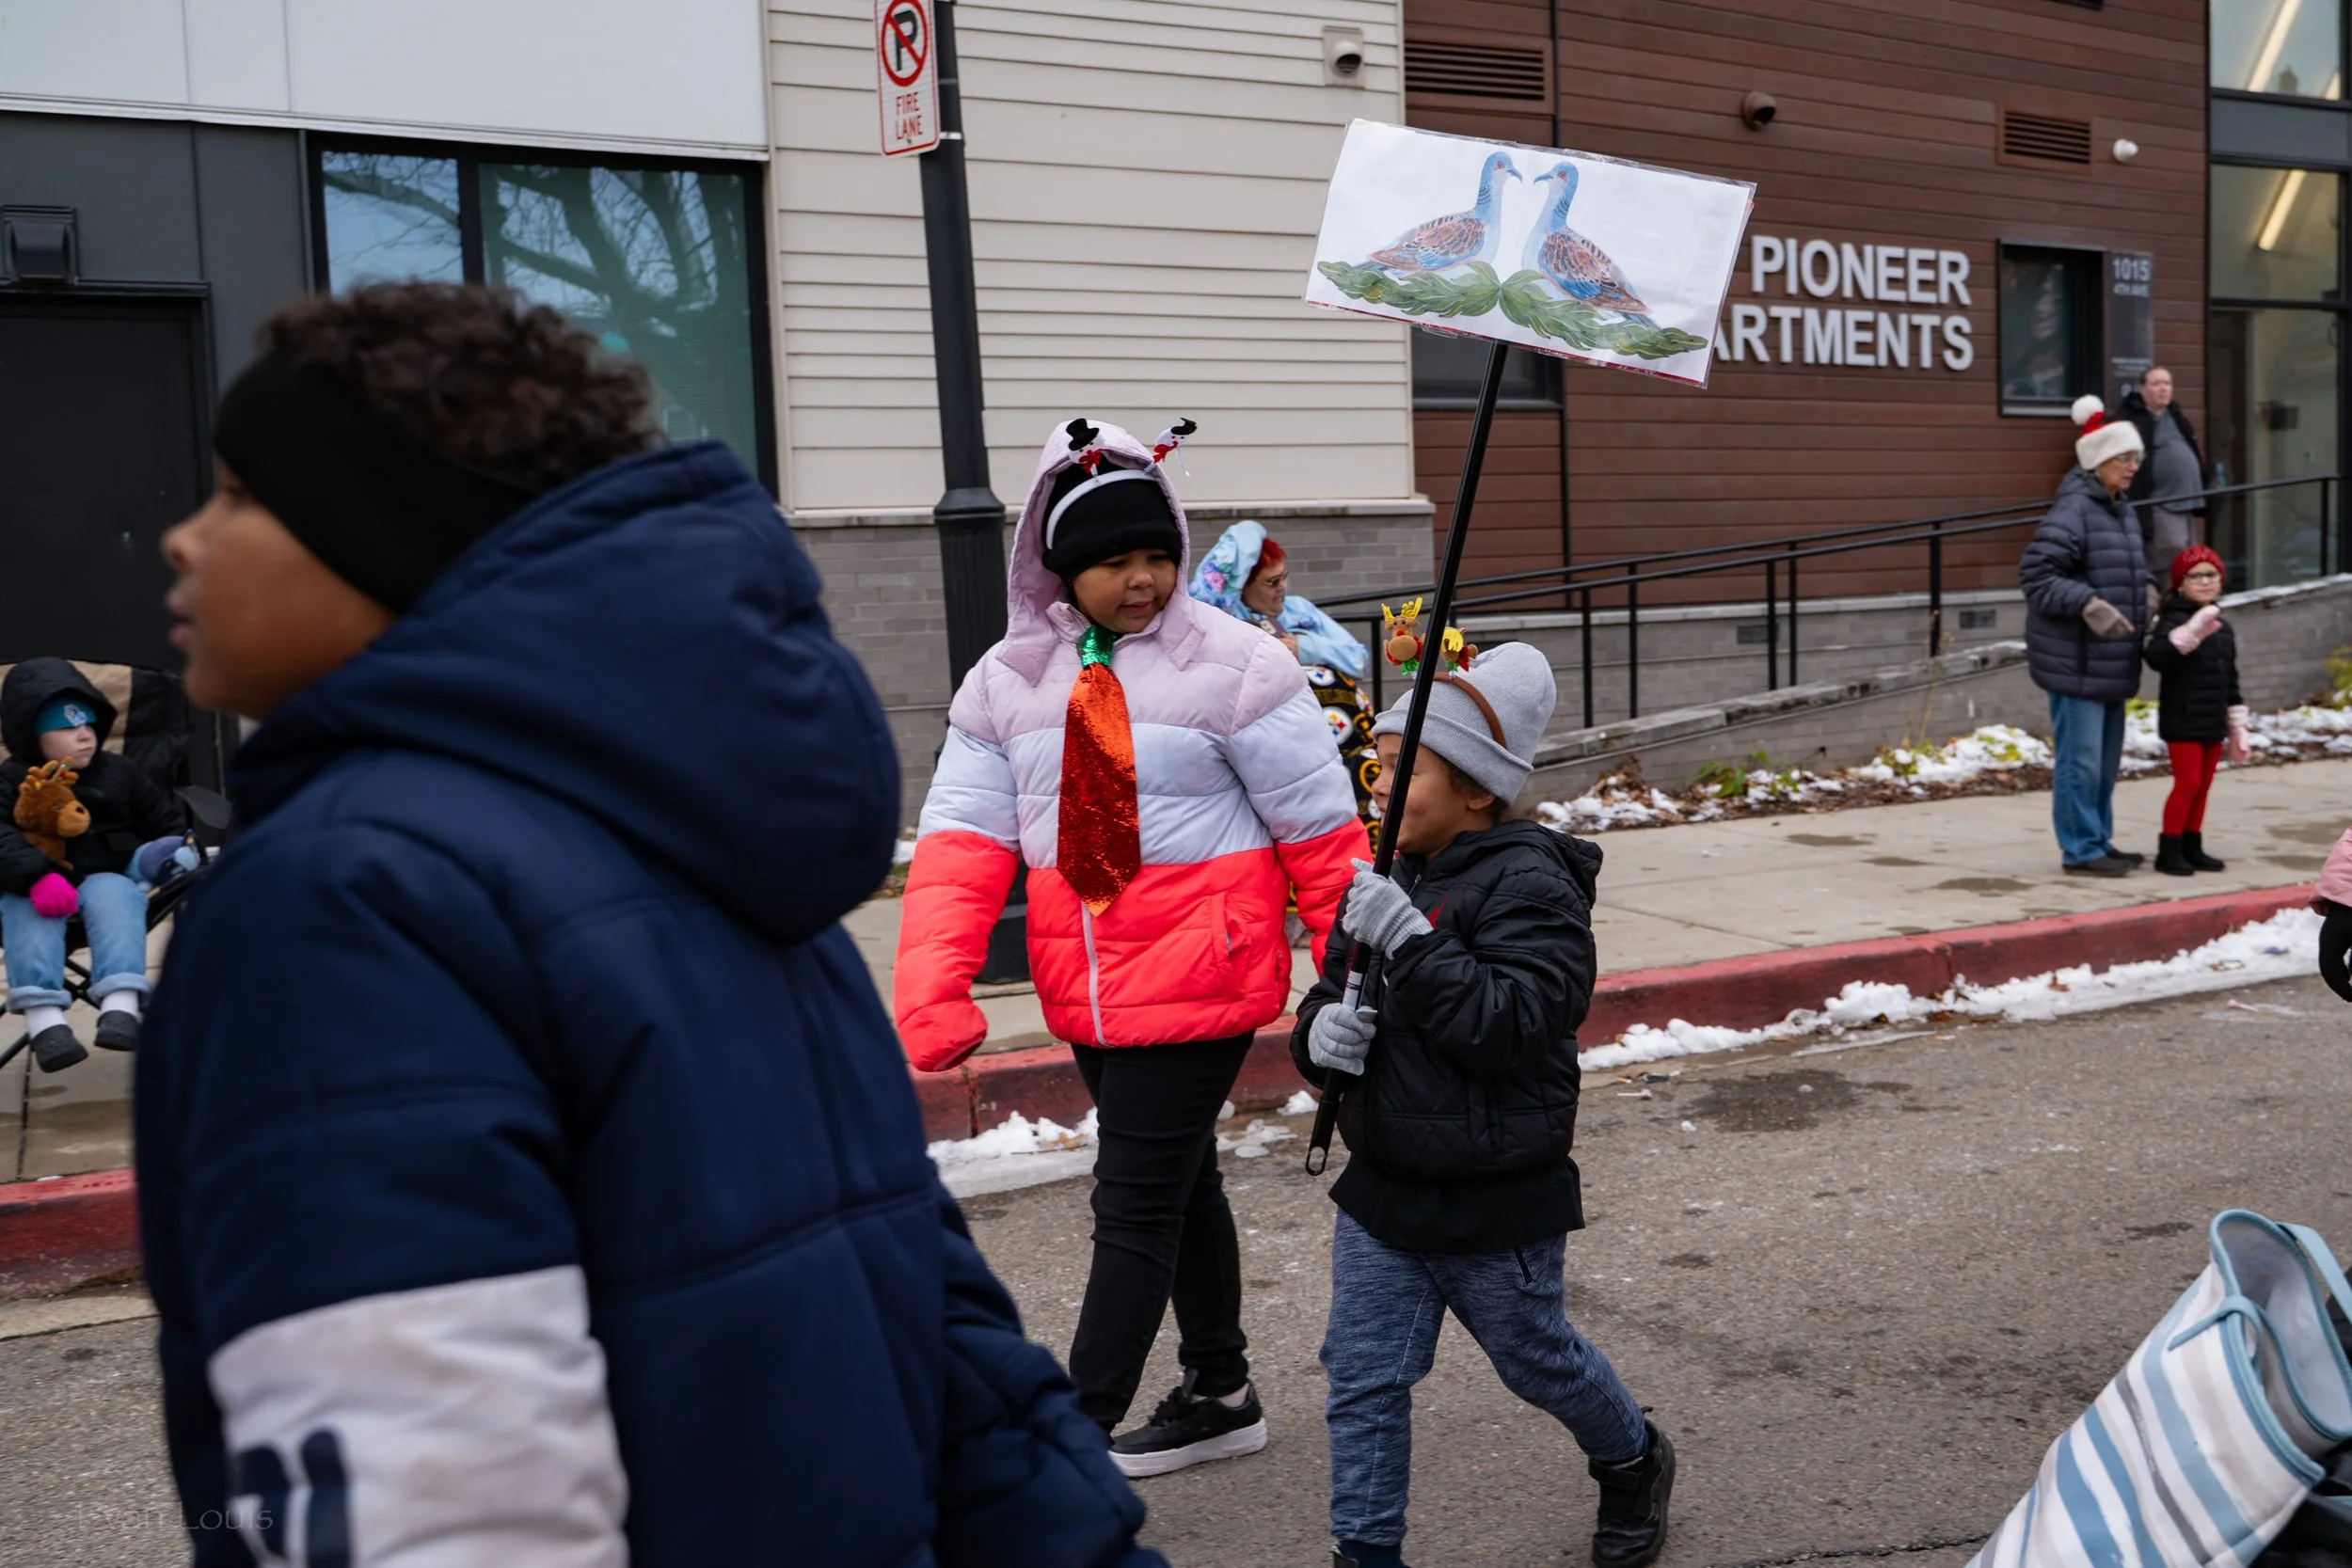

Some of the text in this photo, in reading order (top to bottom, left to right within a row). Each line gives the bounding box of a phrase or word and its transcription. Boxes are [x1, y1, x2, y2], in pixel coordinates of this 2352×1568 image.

[896, 91, 920, 116] FIRE
[896, 115, 923, 140] LANE
[1752, 234, 1972, 306] PIONEER
[2112, 258, 2151, 281] 1015
